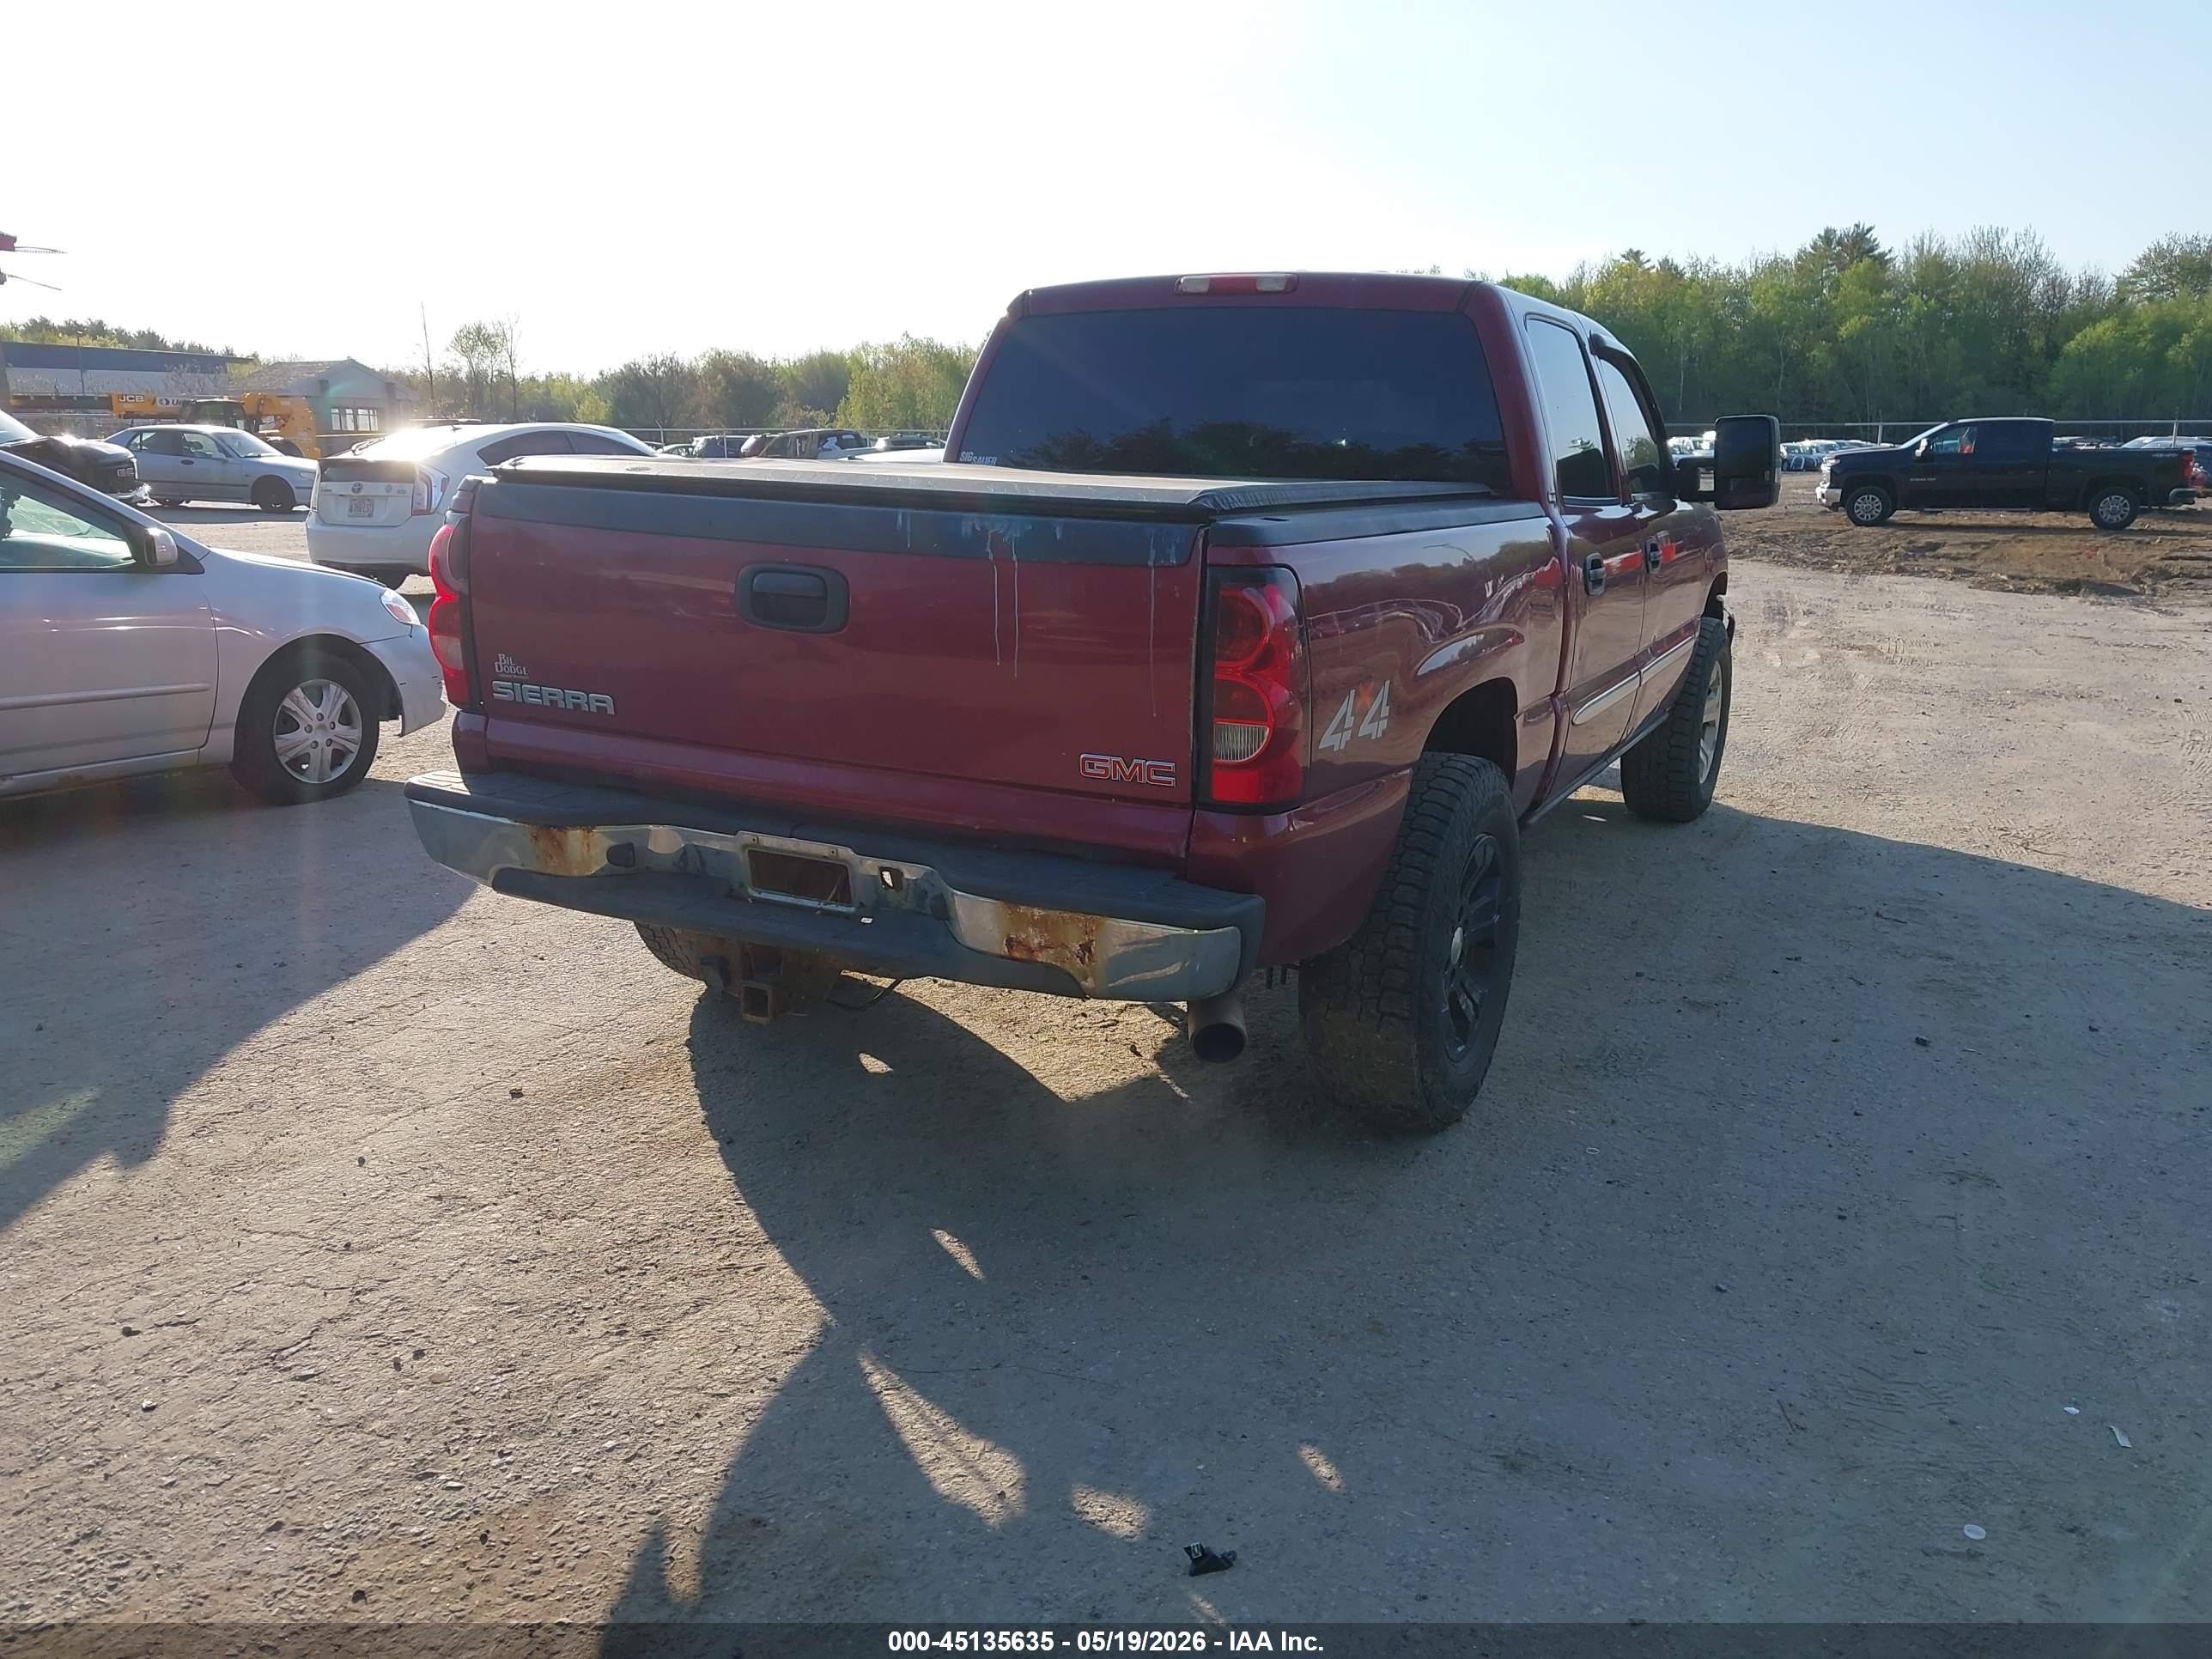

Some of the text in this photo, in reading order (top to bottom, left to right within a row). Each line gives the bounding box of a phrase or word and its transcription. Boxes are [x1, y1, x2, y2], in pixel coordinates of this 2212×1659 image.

[118, 394, 145, 403] JCB
[959, 451, 974, 462] SIG
[492, 680, 616, 715] SIERRA
[1079, 752, 1176, 788] GMC
